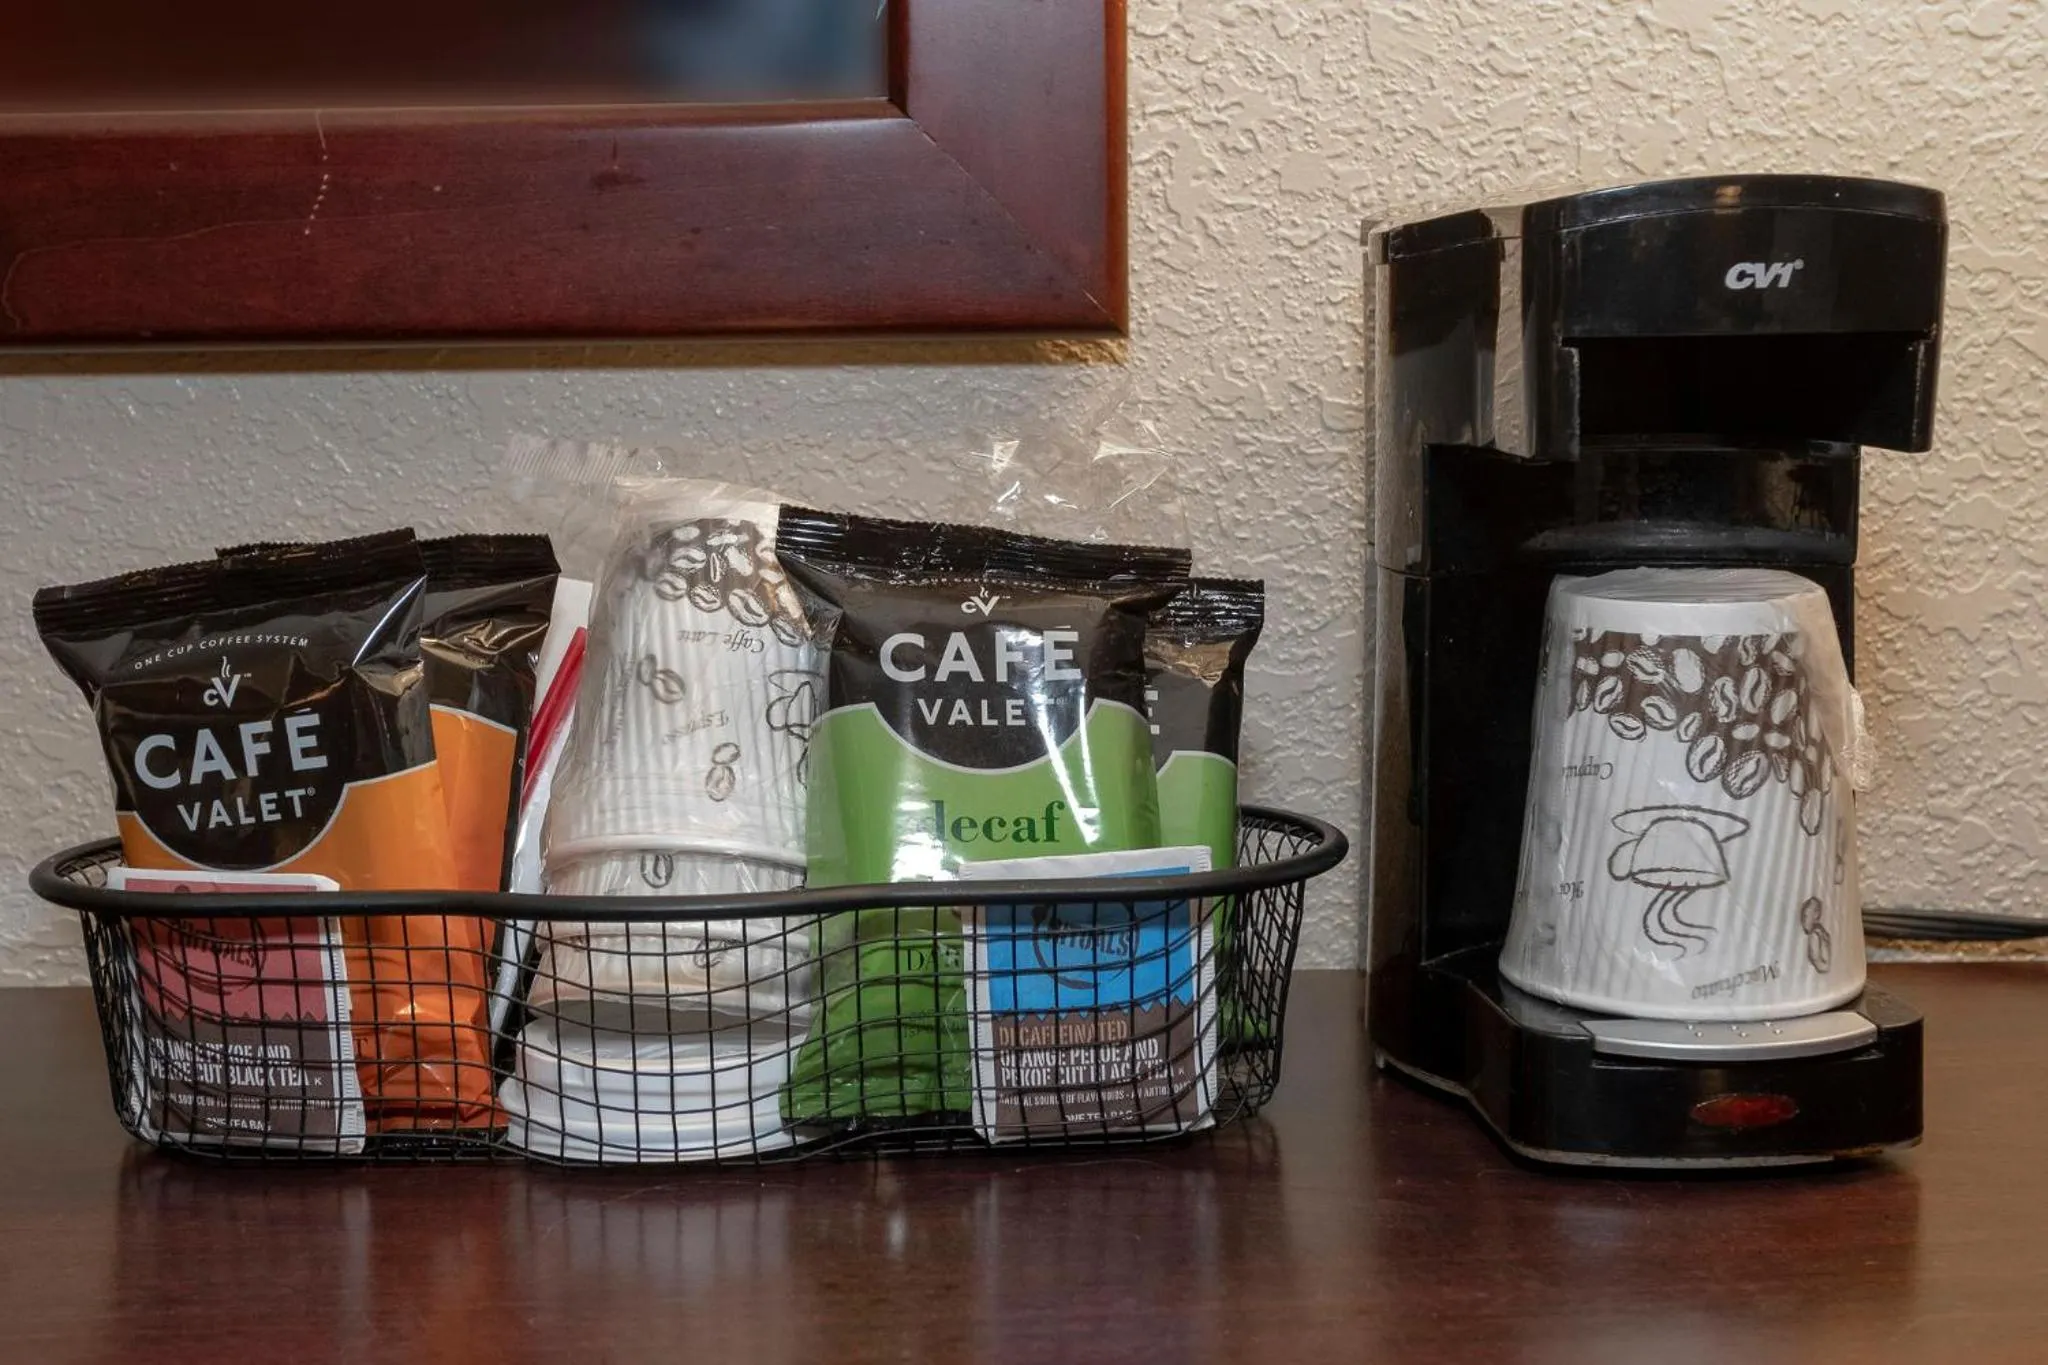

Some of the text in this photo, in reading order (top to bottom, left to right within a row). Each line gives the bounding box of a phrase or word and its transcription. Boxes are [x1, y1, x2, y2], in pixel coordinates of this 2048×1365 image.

[134, 634, 309, 671] ONE CUP COFFEE SYSTEM
[277, 1066, 310, 1087] TEA
